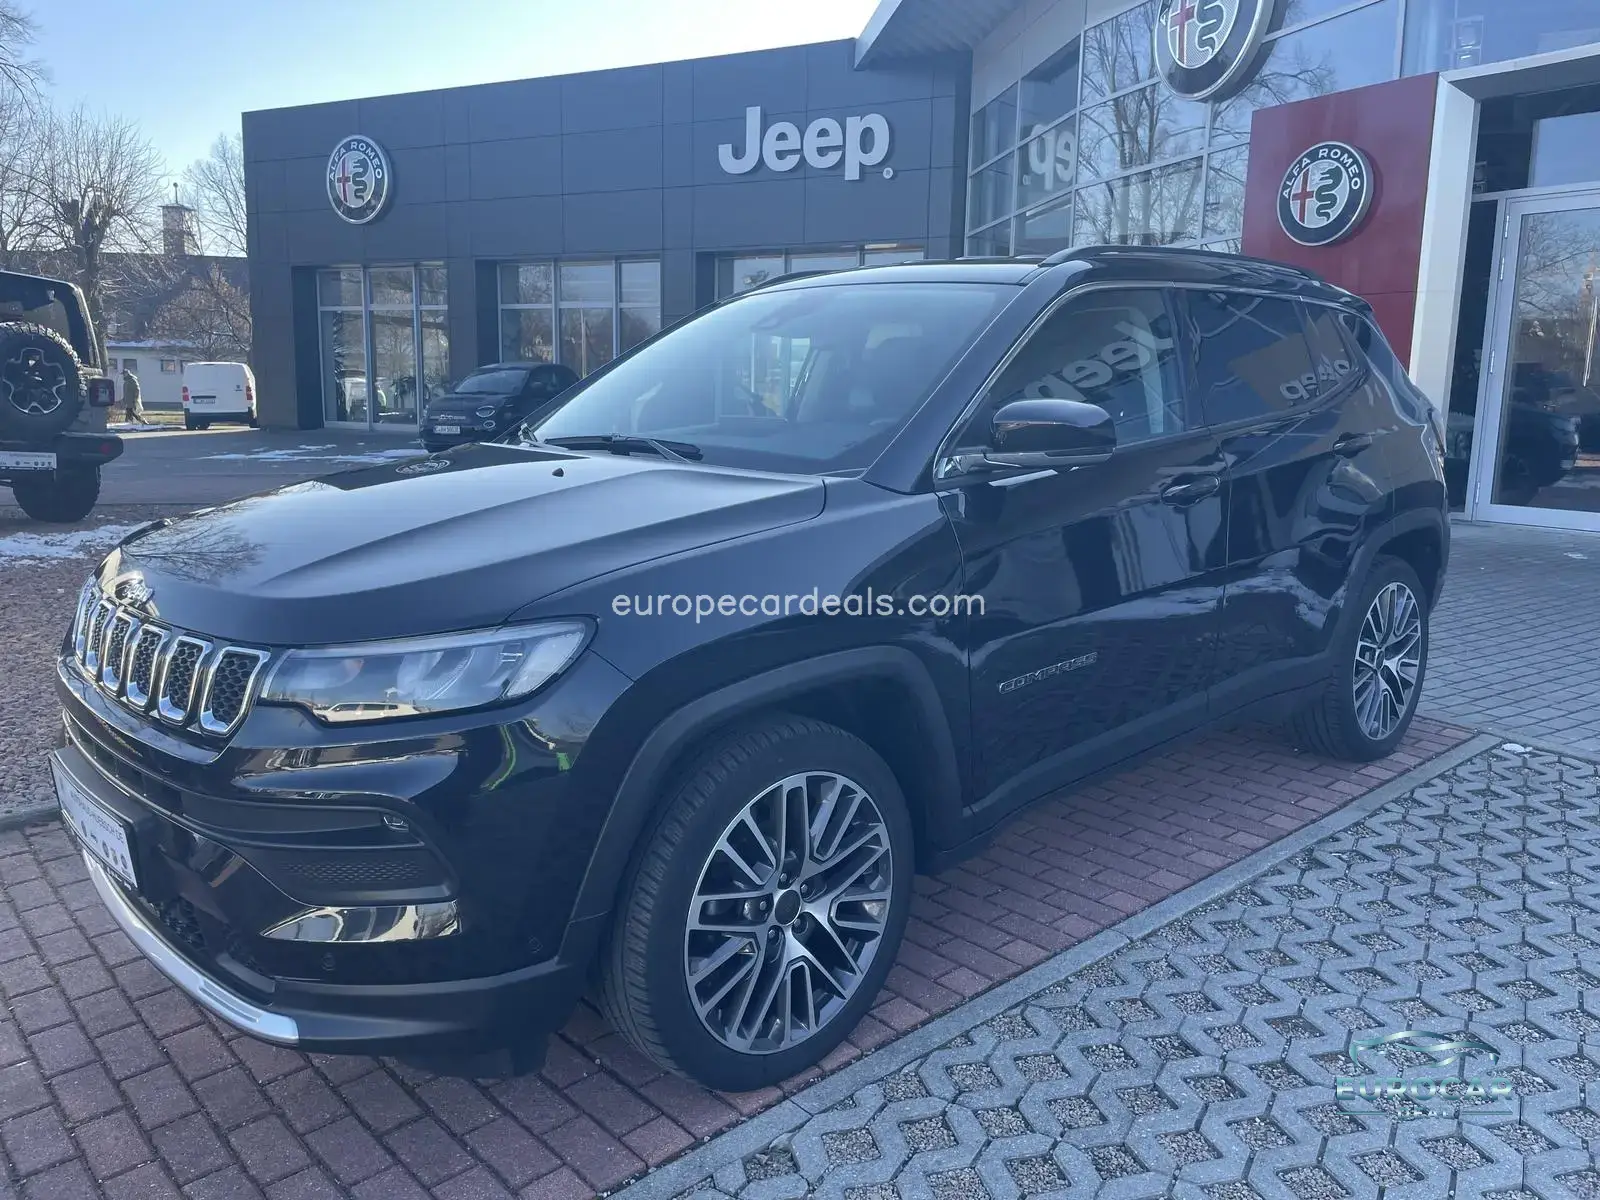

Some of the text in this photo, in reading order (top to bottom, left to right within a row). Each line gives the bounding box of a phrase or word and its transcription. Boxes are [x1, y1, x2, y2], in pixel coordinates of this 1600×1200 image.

[330, 141, 382, 181] ALFA ROMEO
[718, 106, 890, 180] Jeep
[1283, 148, 1360, 199] ALFA ROMEO
